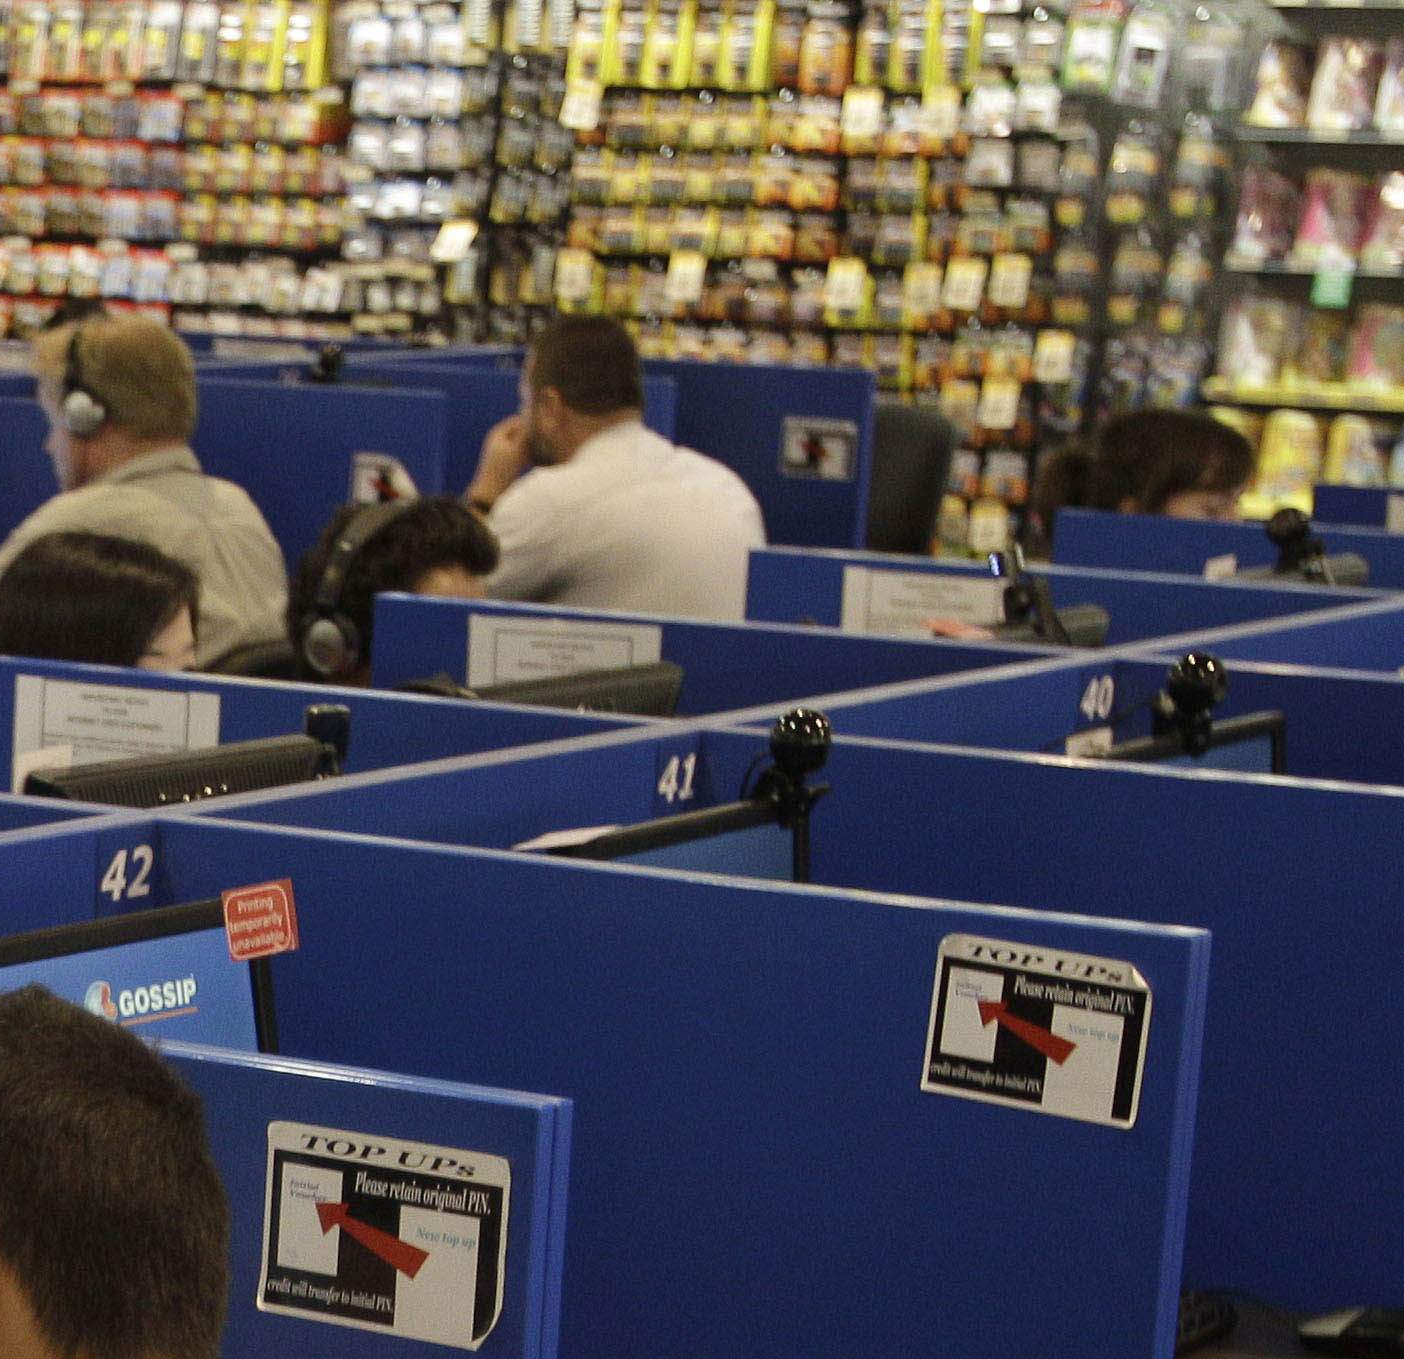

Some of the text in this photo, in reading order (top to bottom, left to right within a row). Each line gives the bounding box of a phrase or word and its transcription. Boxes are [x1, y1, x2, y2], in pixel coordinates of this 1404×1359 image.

[1080, 675, 1115, 720] 40
[657, 752, 697, 803] 41
[101, 844, 153, 901] 42
[237, 896, 273, 914] Printing
[968, 944, 1044, 967] TOP
[118, 977, 197, 1018] GOSSIP
[300, 1132, 386, 1160] TOP
[355, 1170, 389, 1197] Please
[390, 1180, 423, 1203] retain
[423, 1185, 467, 1213] original
[416, 1225, 477, 1251] New top up
